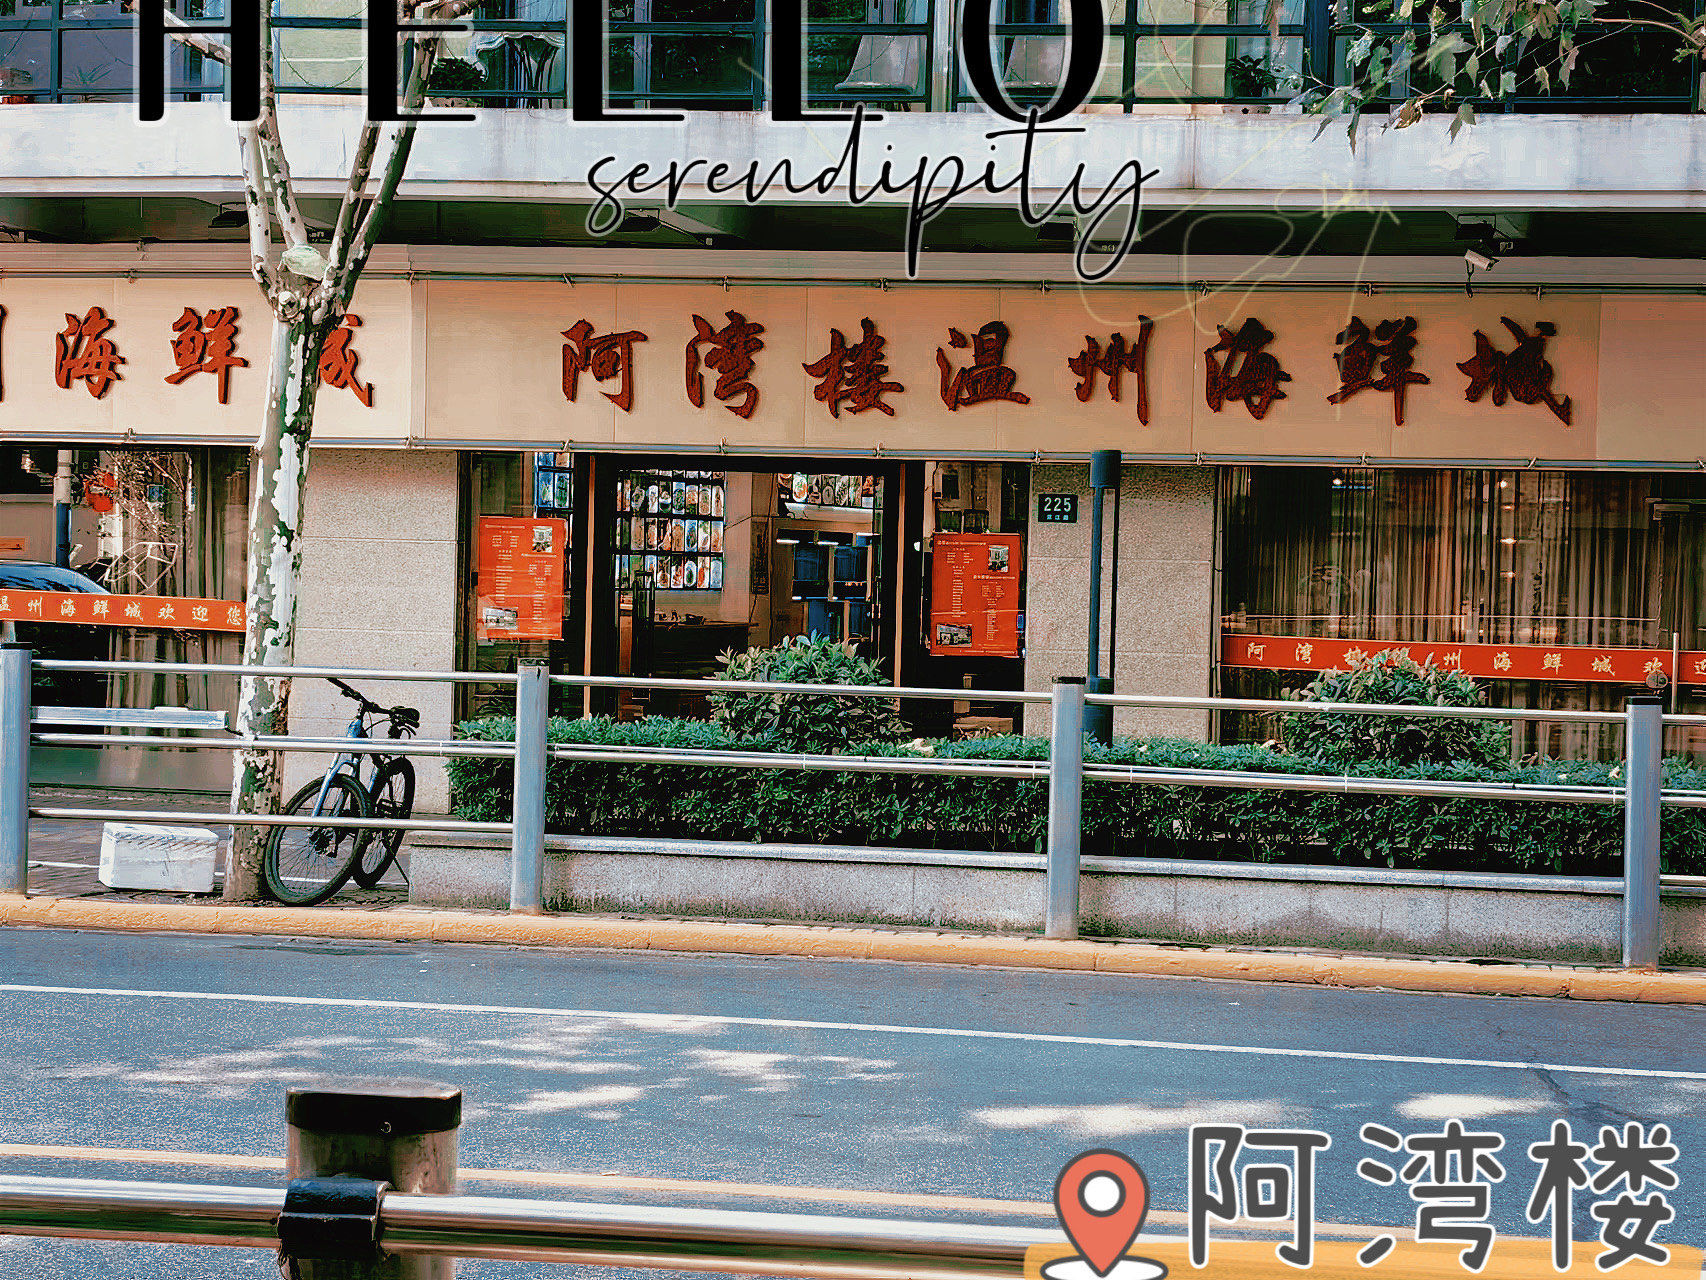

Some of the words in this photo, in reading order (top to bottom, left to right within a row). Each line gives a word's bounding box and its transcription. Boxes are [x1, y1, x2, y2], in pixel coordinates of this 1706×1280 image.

[0, 304, 375, 408] 海鲜城
[560, 311, 1573, 426] 阿湾楼温州海鲜城
[1044, 497, 1072, 512] 225
